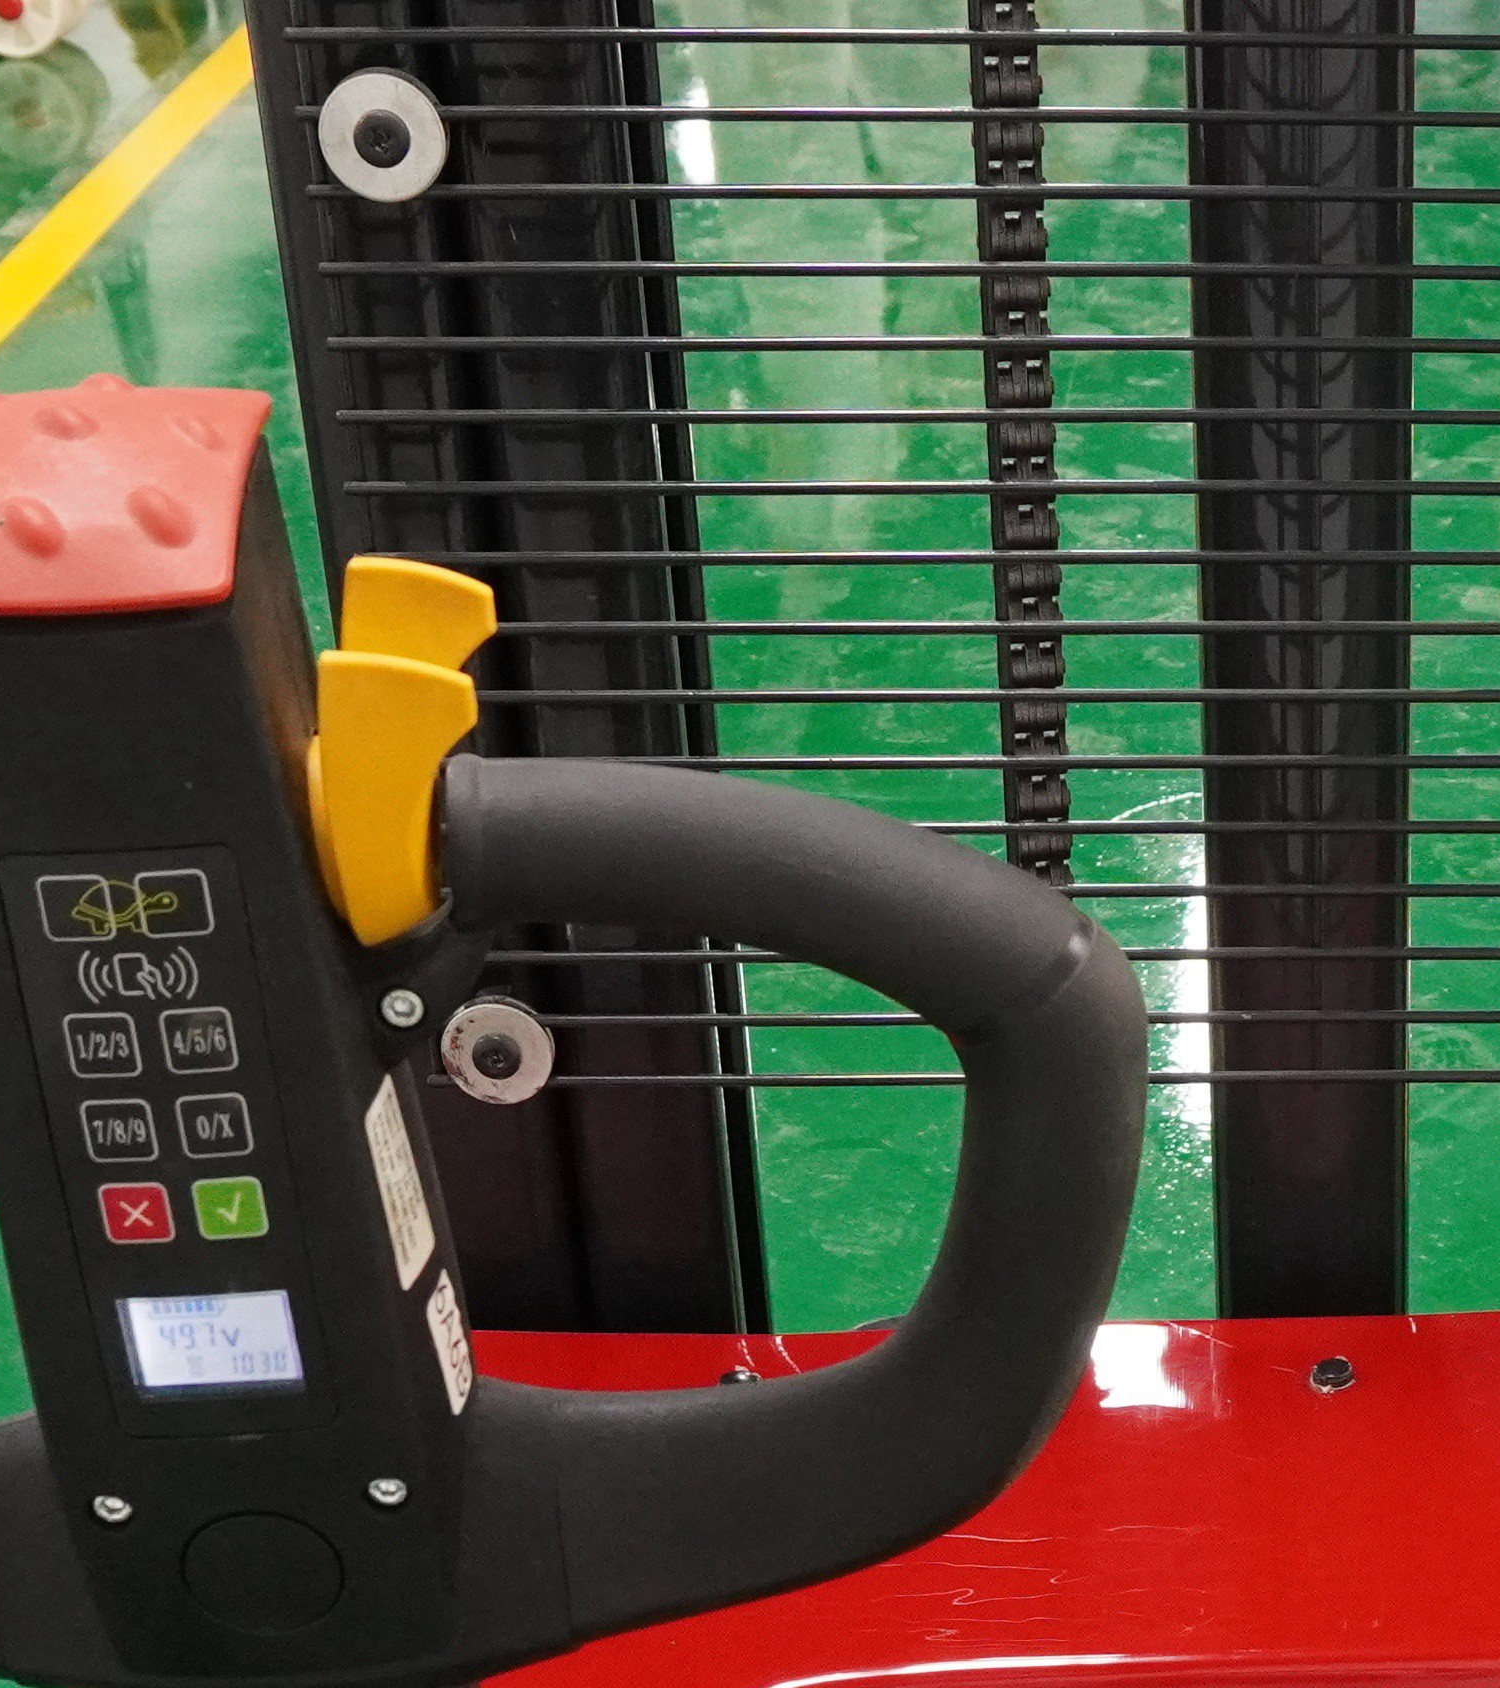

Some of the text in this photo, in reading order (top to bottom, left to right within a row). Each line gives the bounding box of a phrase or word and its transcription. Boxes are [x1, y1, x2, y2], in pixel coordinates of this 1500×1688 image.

[77, 1030, 129, 1060] 1/2/3
[174, 1025, 227, 1055] 4/5/6
[92, 1117, 146, 1146] 7/8/9
